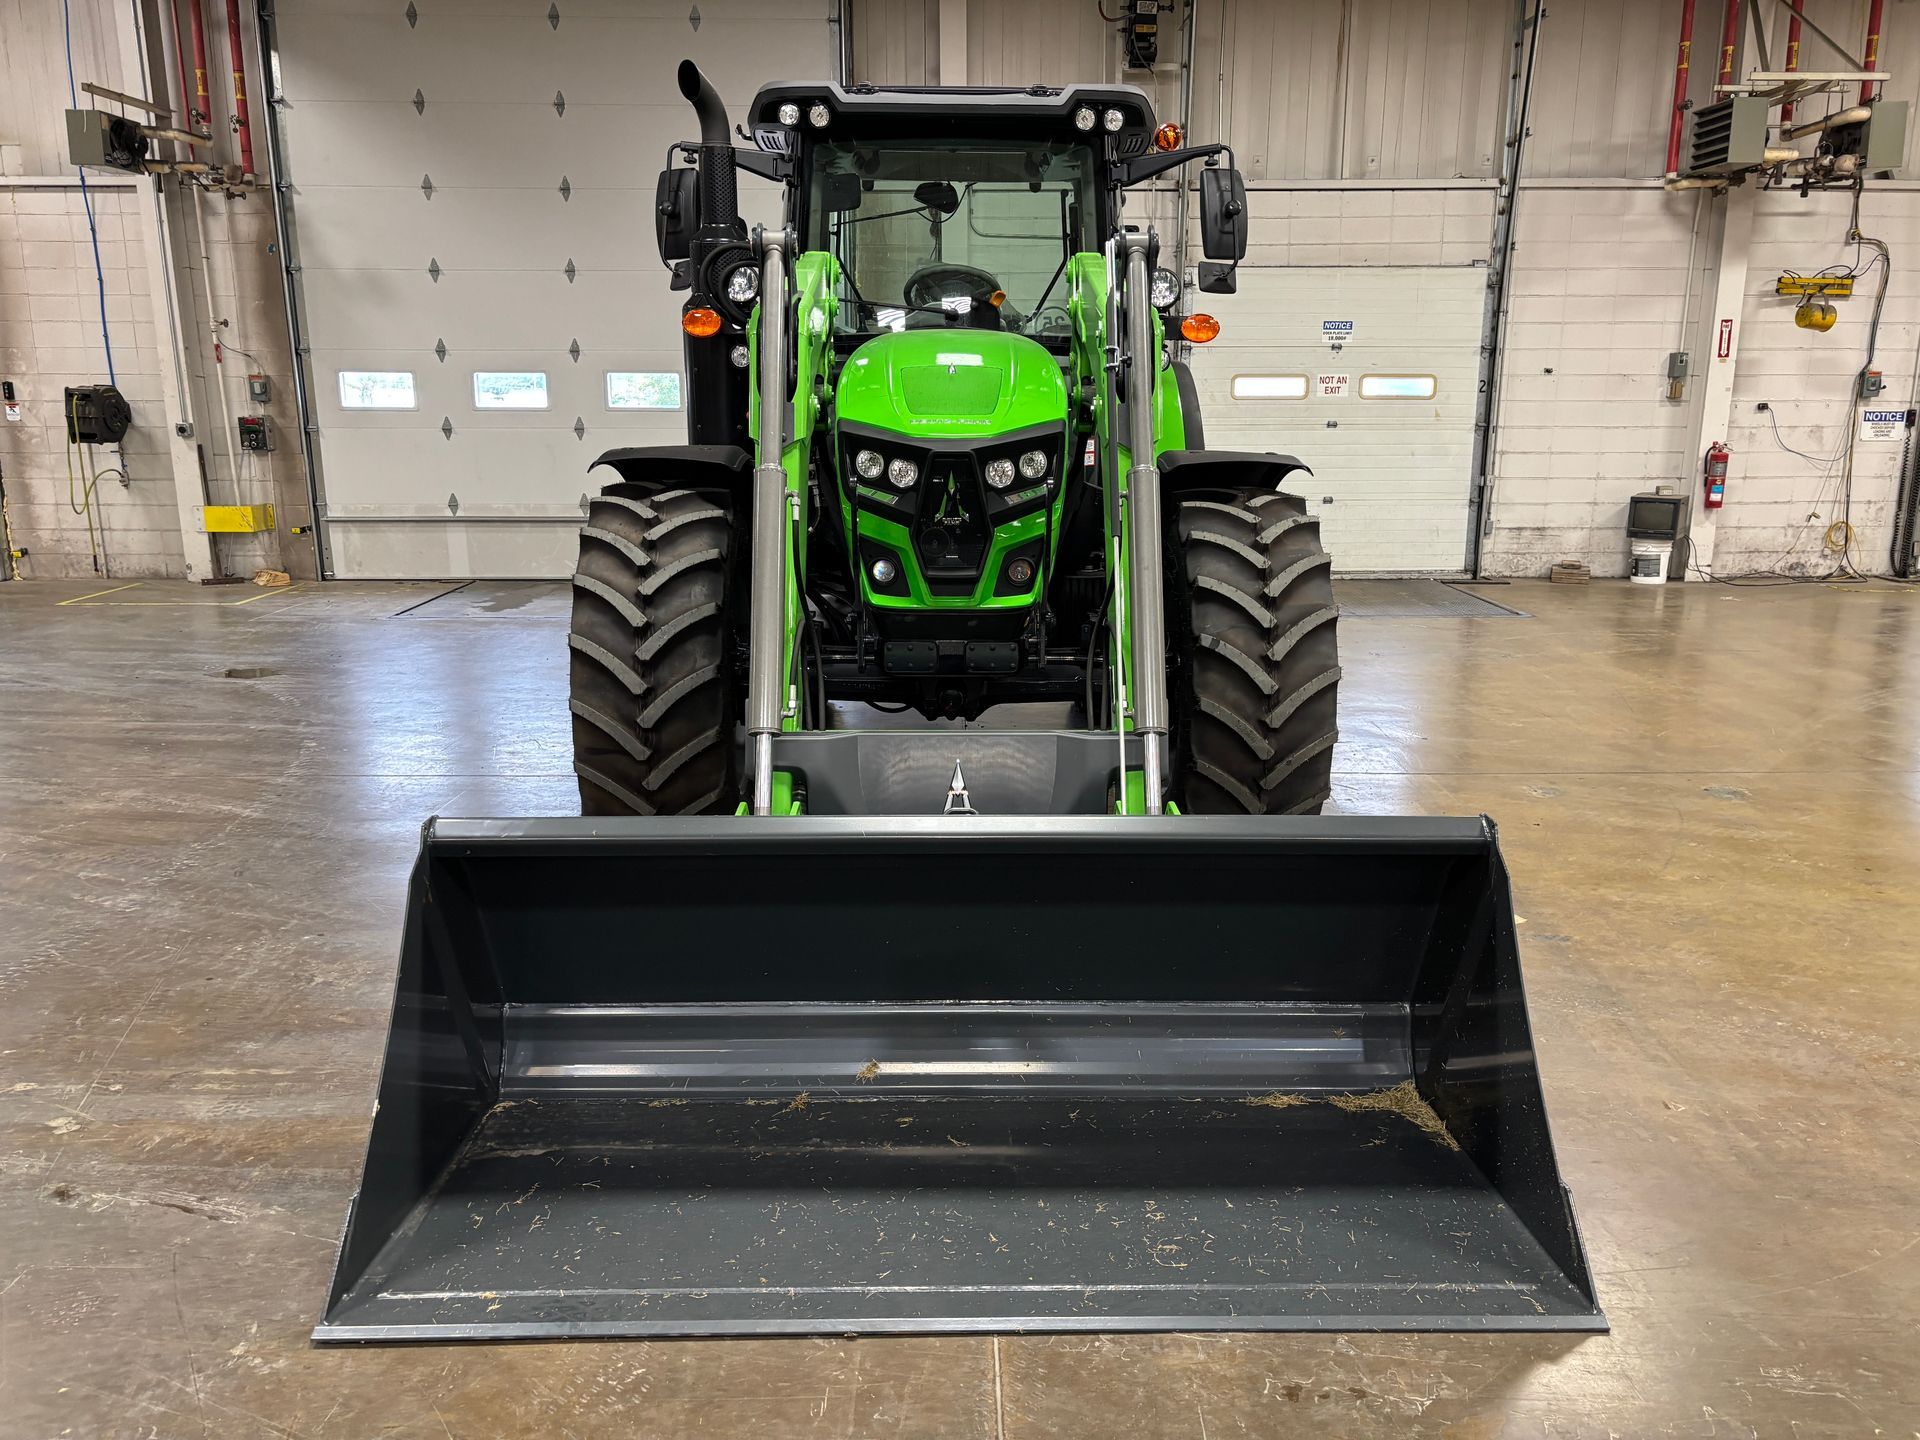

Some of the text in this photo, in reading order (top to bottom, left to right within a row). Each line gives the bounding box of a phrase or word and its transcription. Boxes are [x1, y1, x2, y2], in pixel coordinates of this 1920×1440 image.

[1319, 376, 1347, 384] NOT AN
[1325, 386, 1341, 394] EXIT
[1479, 379, 1486, 393] 2
[1865, 412, 1903, 421] NOTICE
